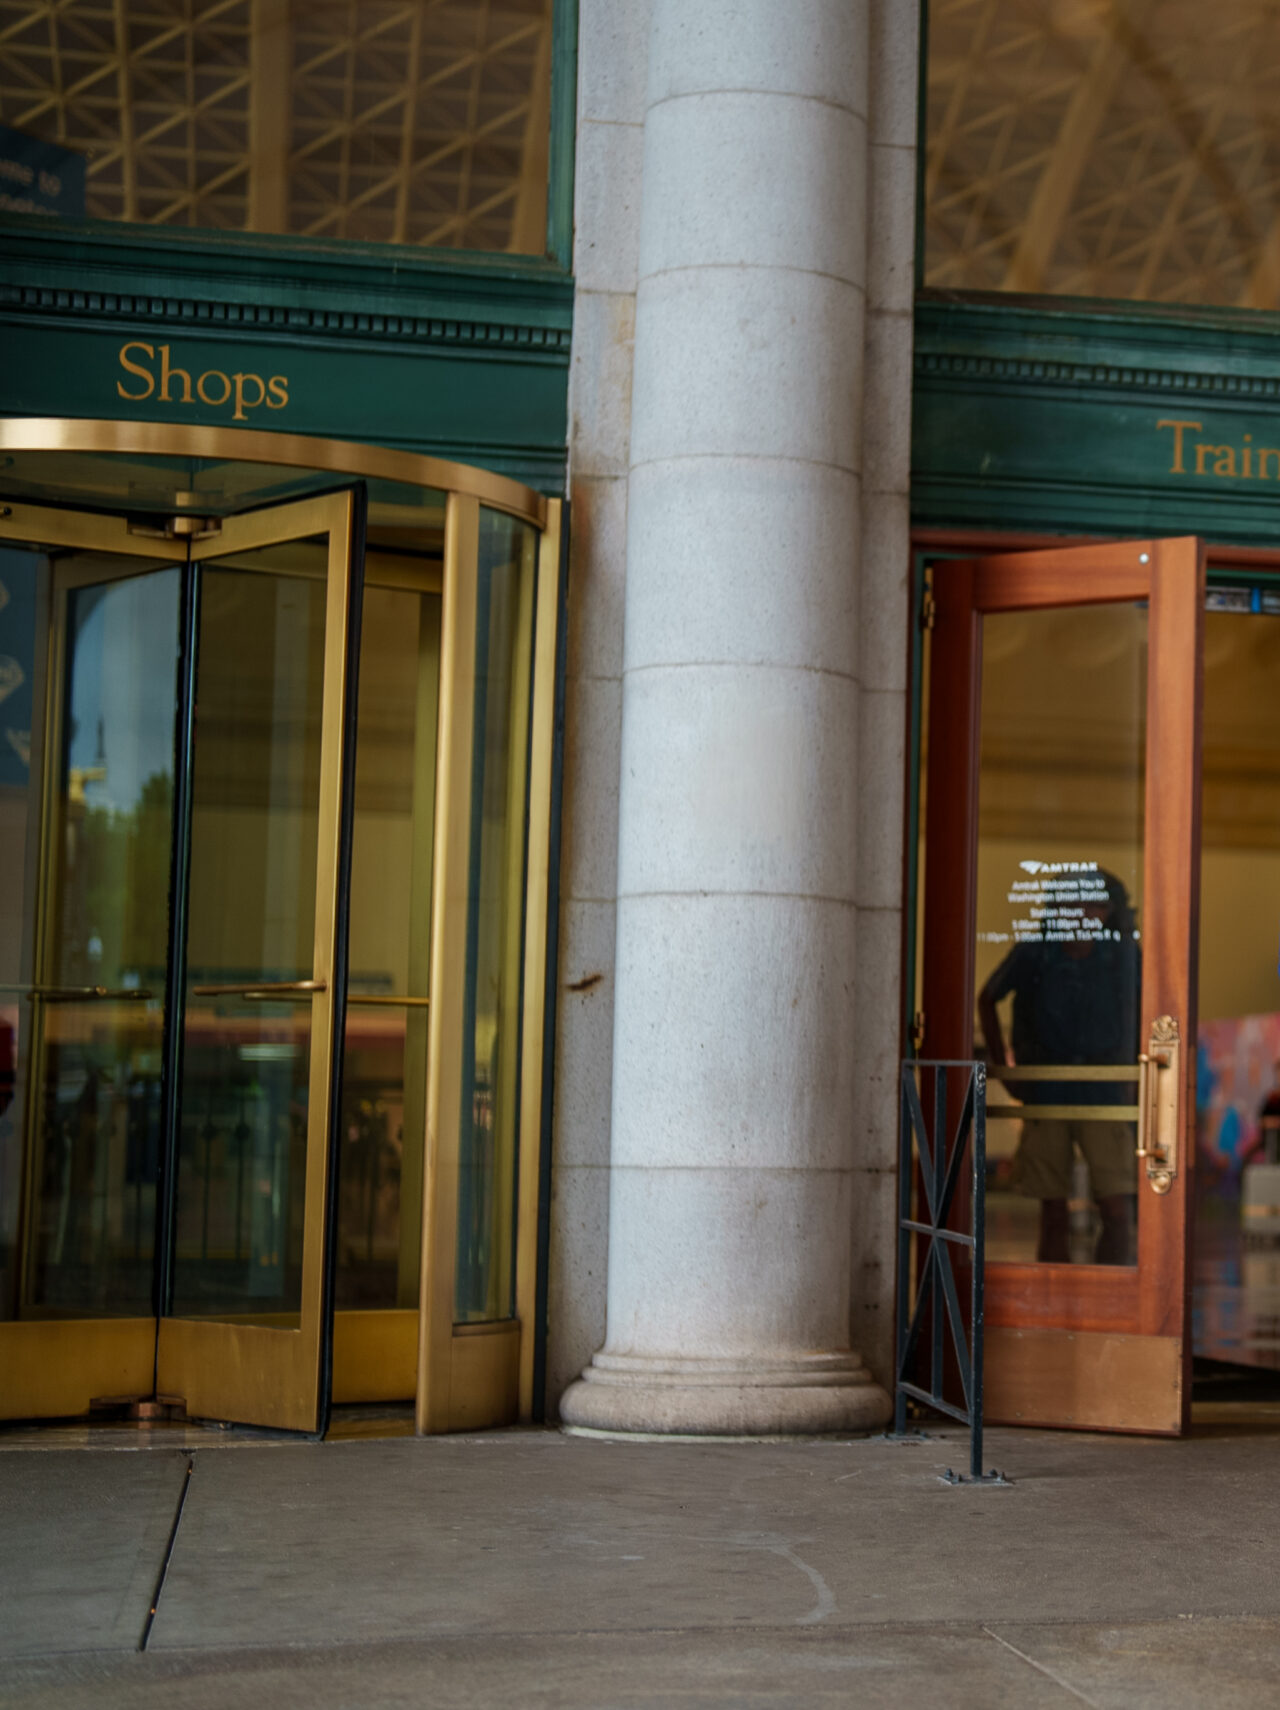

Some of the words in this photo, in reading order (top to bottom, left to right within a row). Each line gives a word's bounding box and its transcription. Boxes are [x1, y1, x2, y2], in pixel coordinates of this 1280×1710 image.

[117, 341, 289, 421] Shops
[1040, 861, 1098, 873] AMTRAK
[1012, 880, 1040, 891] Amtrak
[1079, 878, 1094, 889] You
[1008, 892, 1055, 904] Washington
[1055, 891, 1079, 902] Union
[1080, 890, 1109, 901] Station
[1030, 907, 1058, 918] Station
